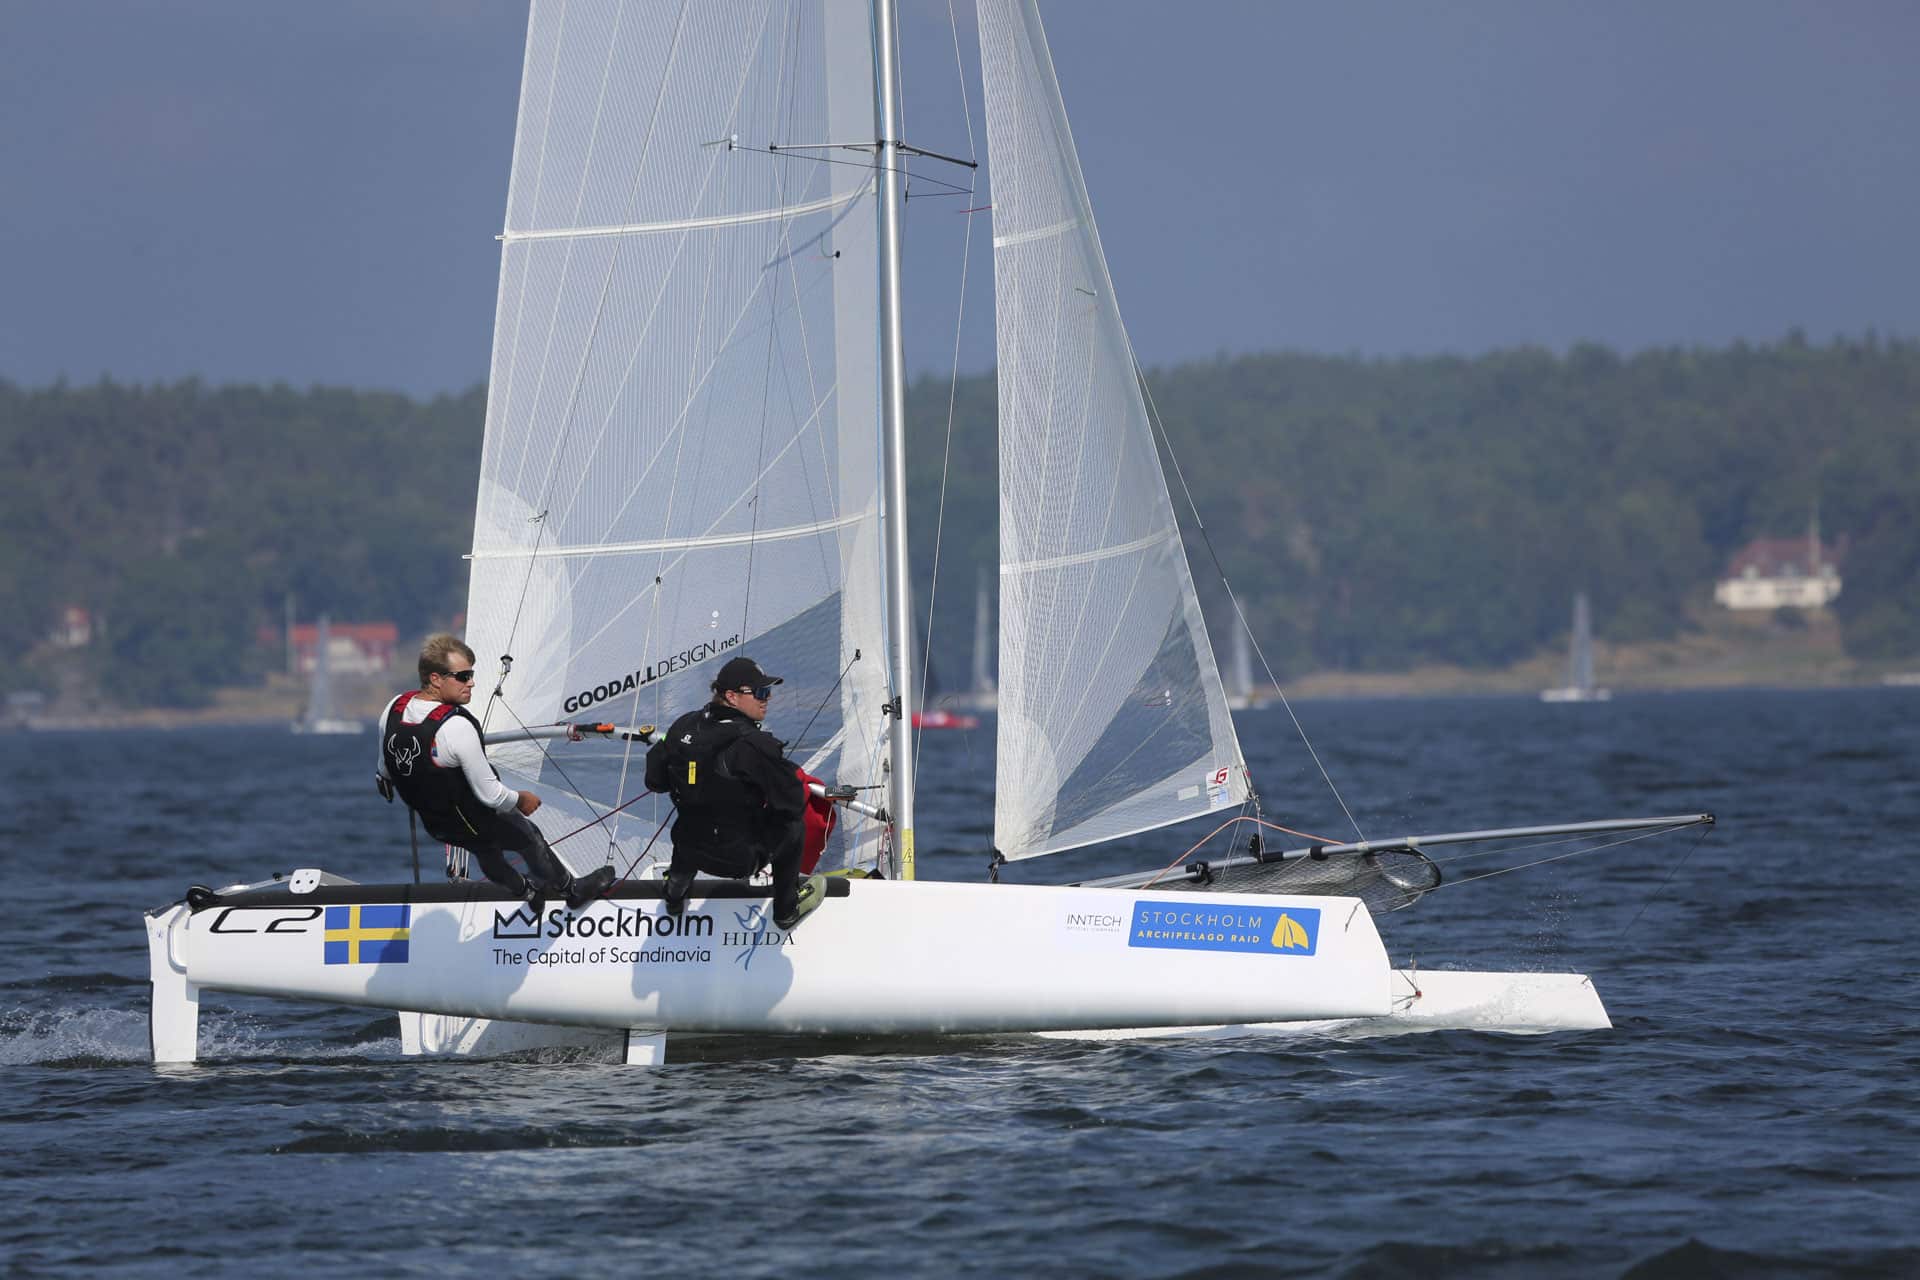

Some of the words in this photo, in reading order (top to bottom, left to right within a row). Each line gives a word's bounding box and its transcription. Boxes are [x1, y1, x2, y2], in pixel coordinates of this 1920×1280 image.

[546, 908, 713, 938] Stockholm
[1140, 911, 1263, 929] STOCKHOLM
[722, 931, 797, 946] HILDA
[1137, 930, 1225, 942] ARCHIPELAGO
[1231, 934, 1260, 943] RAID
[493, 948, 523, 965] The
[526, 948, 586, 968] Capital
[589, 947, 606, 964] of
[609, 947, 711, 964] Scandinavia
